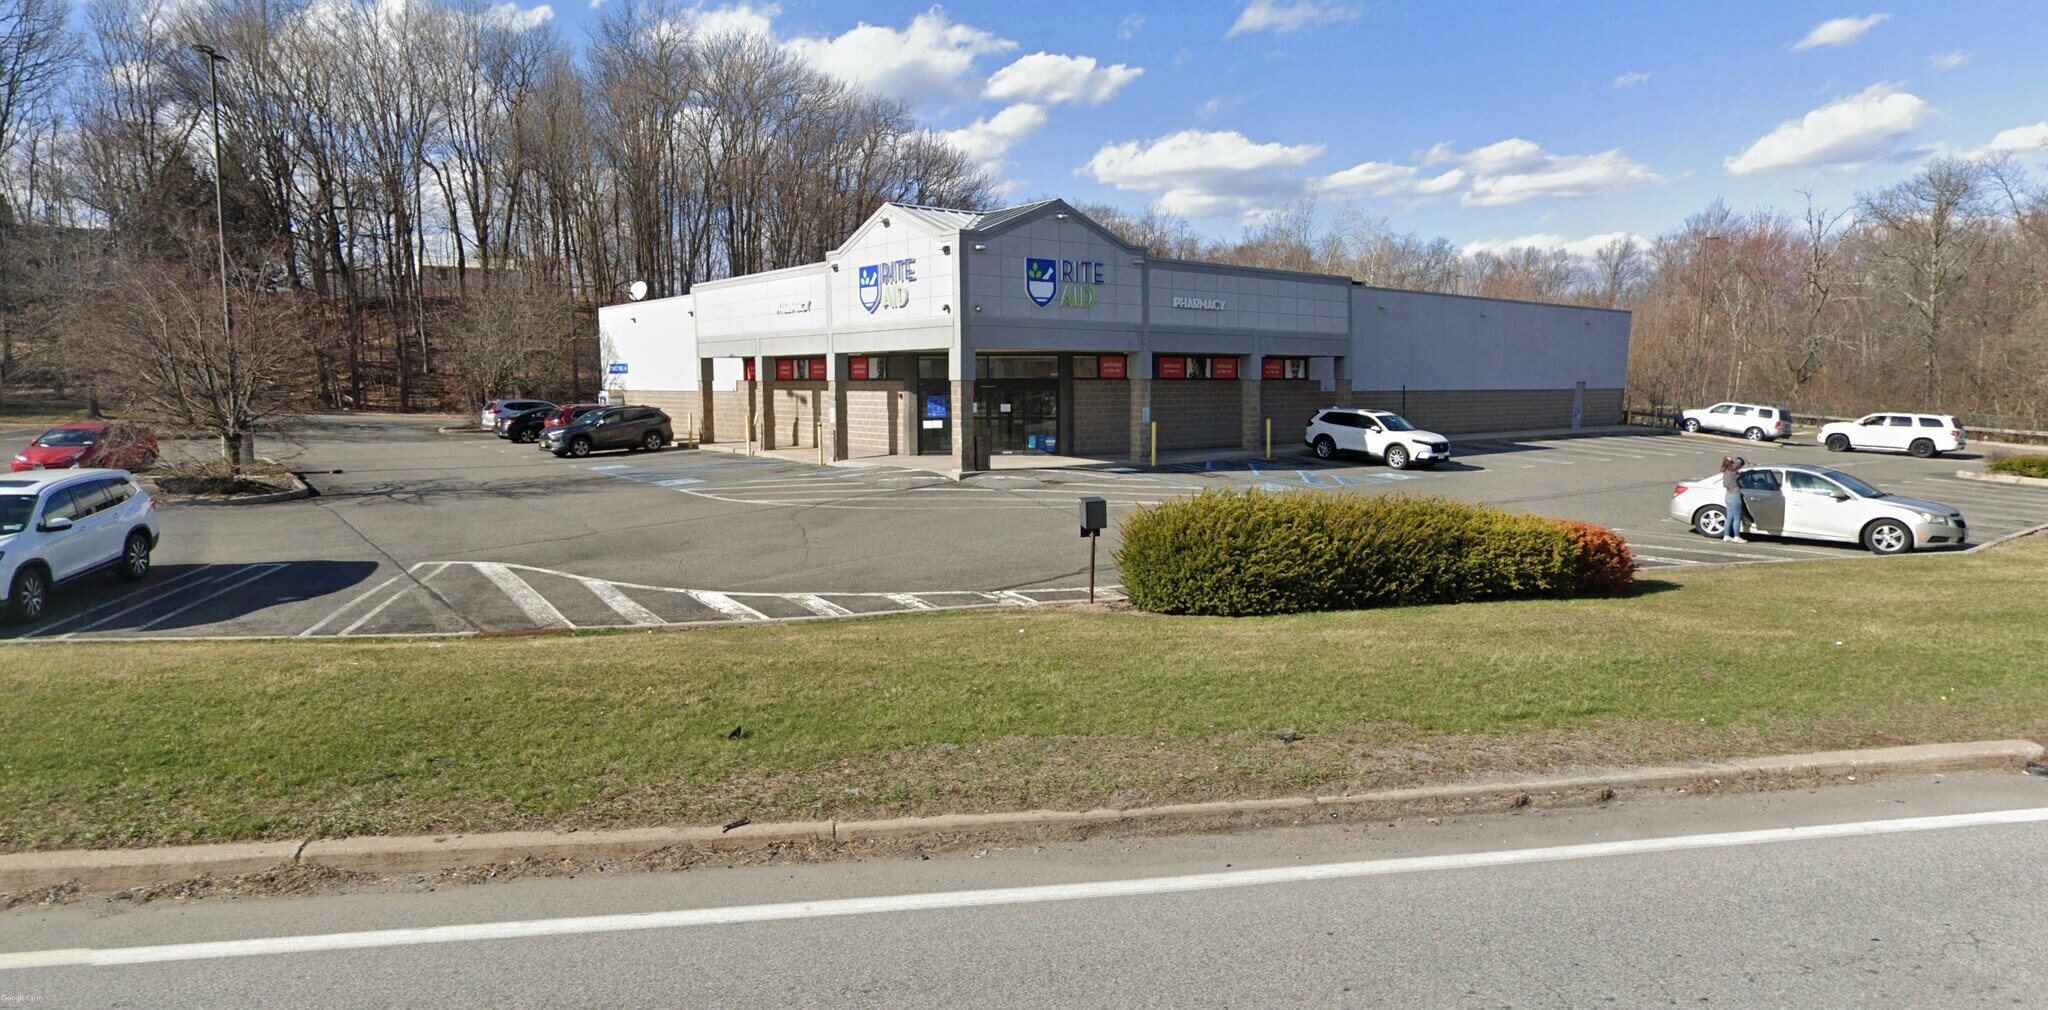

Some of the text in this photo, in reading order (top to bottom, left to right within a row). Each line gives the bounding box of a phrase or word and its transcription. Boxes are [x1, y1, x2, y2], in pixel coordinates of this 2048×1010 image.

[881, 258, 916, 284] RITE
[1060, 260, 1104, 284] RITE
[883, 285, 909, 309] AID
[1060, 285, 1096, 309] AID
[1173, 296, 1226, 310] PHARMACY
